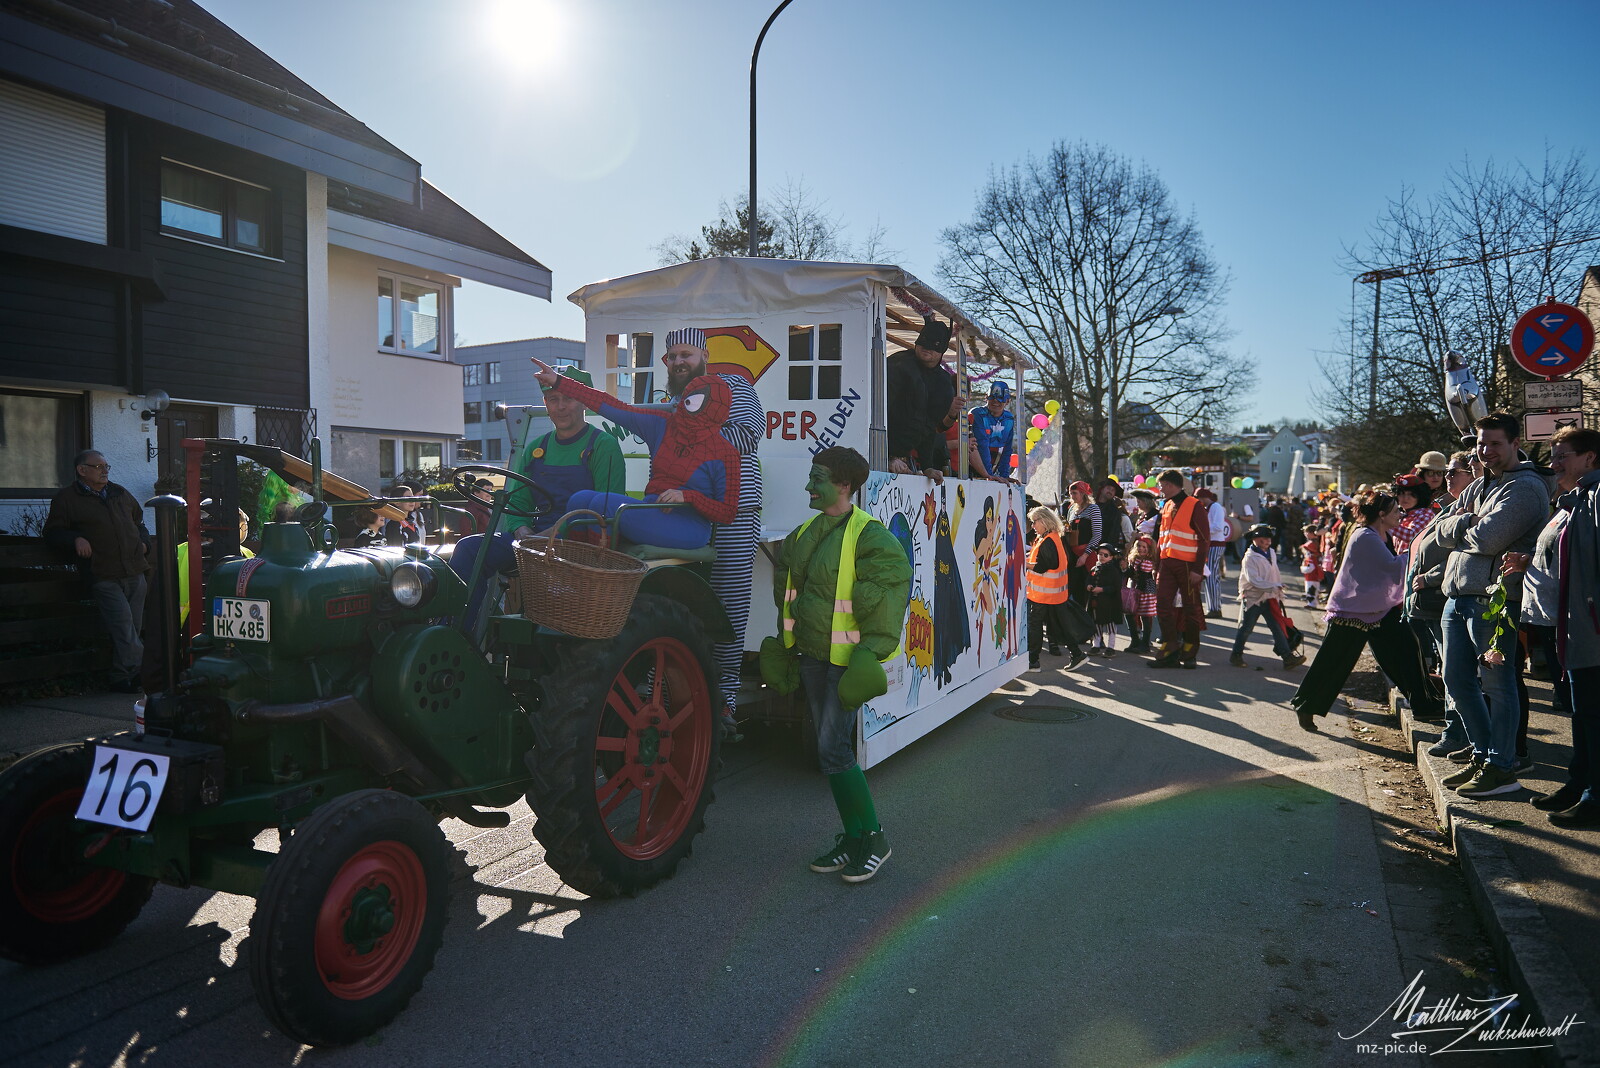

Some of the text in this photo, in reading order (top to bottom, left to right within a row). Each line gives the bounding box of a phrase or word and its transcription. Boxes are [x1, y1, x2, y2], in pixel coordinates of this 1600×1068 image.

[766, 411, 819, 441] PER
[808, 388, 861, 456] HELDEN
[880, 487, 904, 528] ETTEN
[913, 530, 922, 590] WELT
[217, 619, 265, 639] HK 485
[226, 601, 243, 619] TS
[909, 611, 932, 654] BOOM
[95, 753, 158, 822] 16
